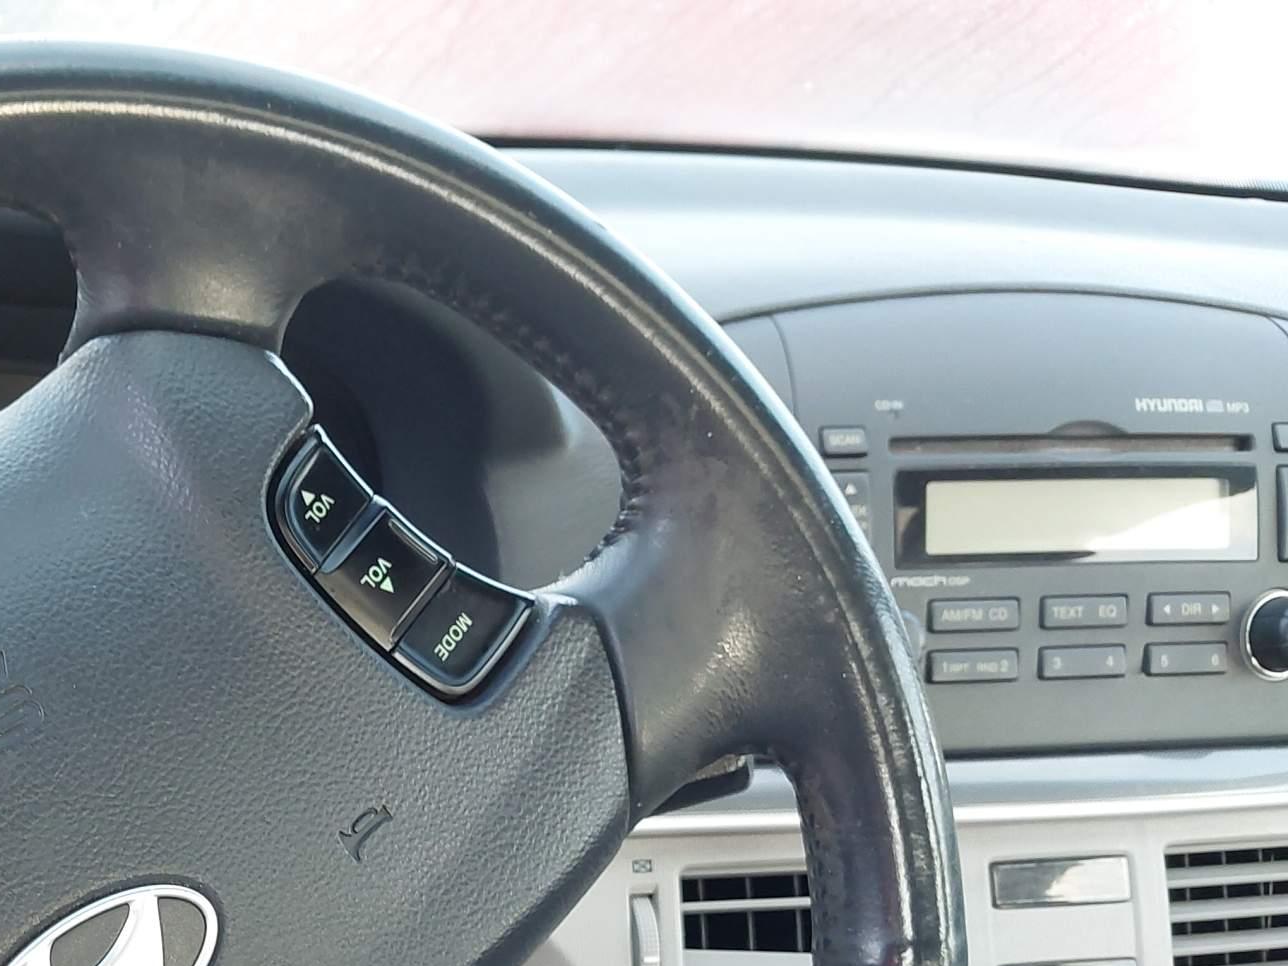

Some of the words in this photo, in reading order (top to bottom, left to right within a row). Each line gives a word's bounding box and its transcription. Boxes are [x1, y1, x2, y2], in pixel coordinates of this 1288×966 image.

[1135, 397, 1203, 413] HYUNDAI
[1226, 402, 1249, 413] MP3
[305, 493, 335, 524] VOL
[359, 557, 392, 588] VOL
[988, 607, 1008, 621] CD
[1053, 606, 1084, 619] TEXT
[1099, 604, 1117, 618] EQ
[1181, 602, 1202, 616] DIR
[434, 612, 473, 661] MODE
[1053, 657, 1063, 670] 3
[1106, 656, 1115, 667] 4
[1161, 654, 1169, 668] 5
[1211, 653, 1220, 666] 6
